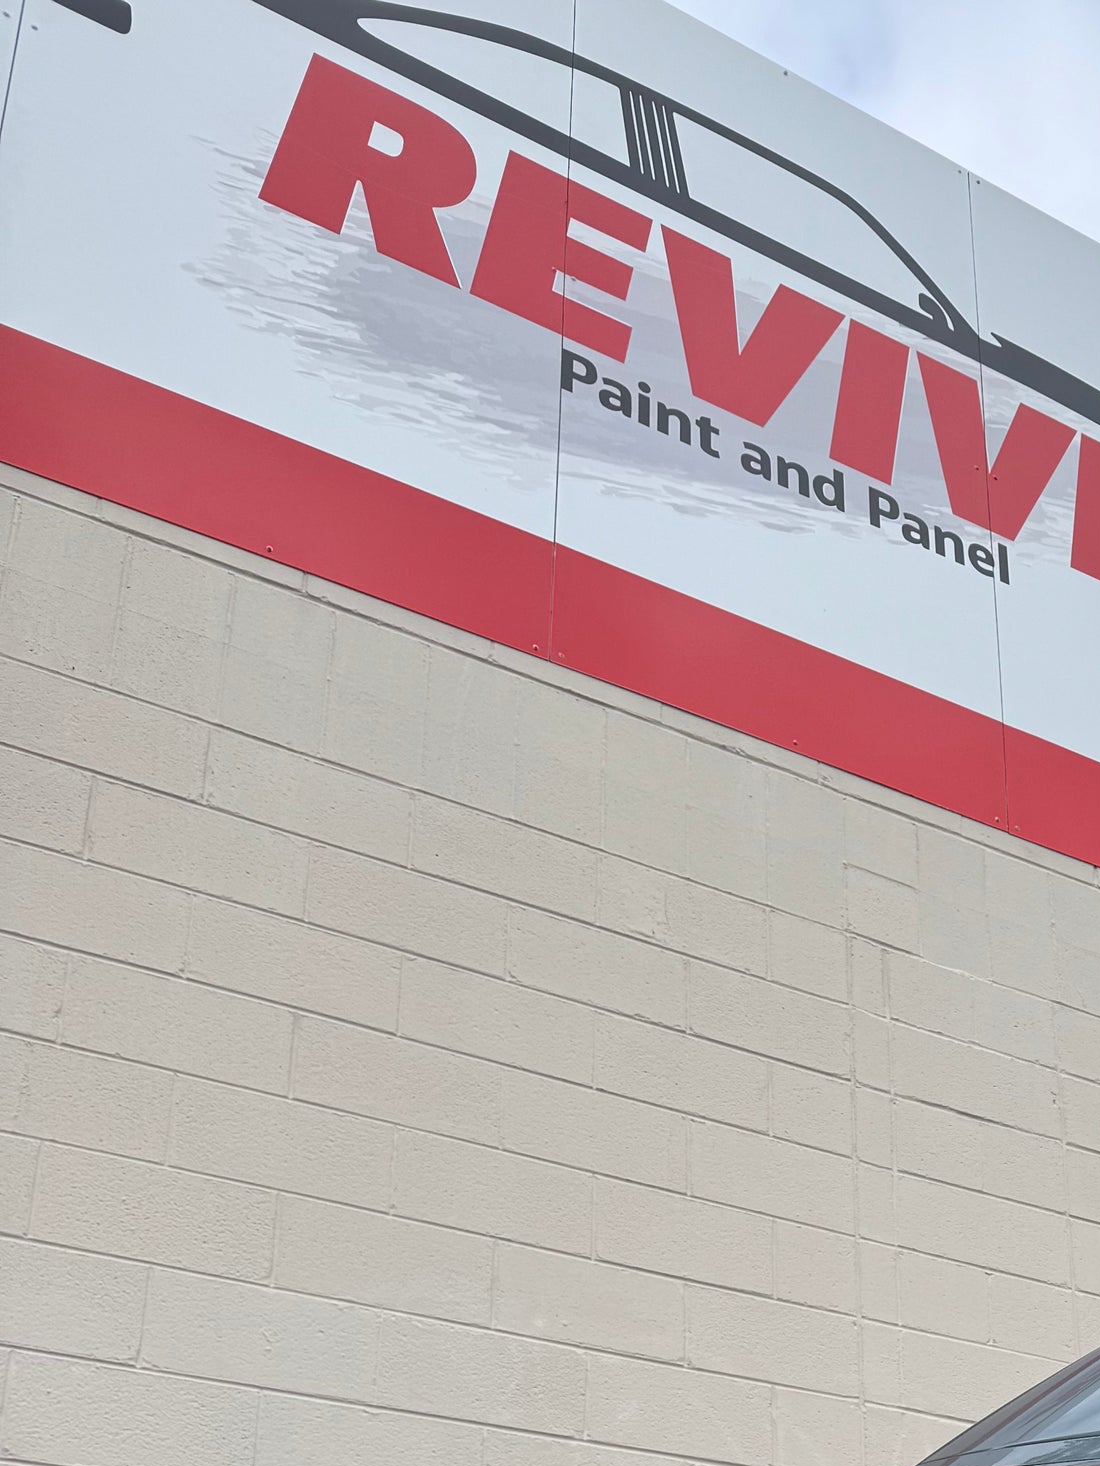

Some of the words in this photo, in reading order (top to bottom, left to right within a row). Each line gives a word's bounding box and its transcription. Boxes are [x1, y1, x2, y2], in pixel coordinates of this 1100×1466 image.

[560, 348, 720, 458] Paint
[740, 440, 845, 512] and
[869, 486, 1011, 585] Panel
